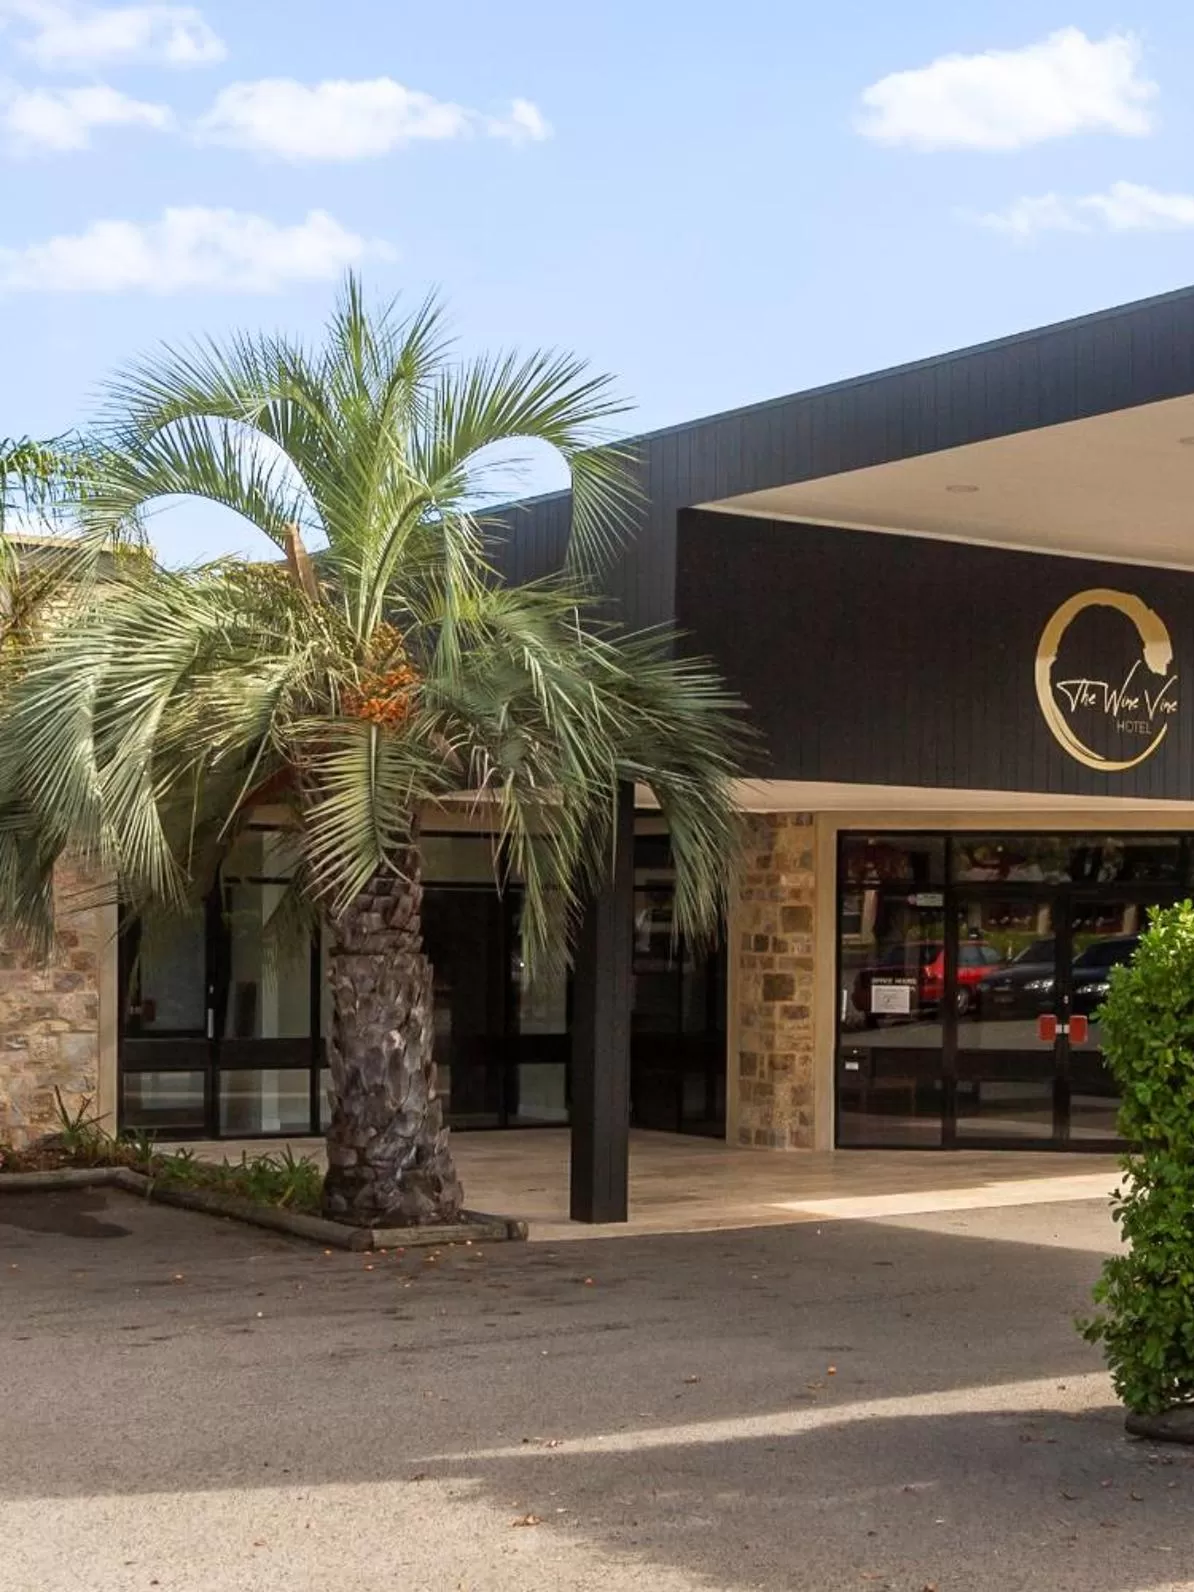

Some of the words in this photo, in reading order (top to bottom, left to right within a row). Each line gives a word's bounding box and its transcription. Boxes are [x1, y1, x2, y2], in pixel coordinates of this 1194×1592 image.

[1056, 678, 1104, 713] The
[1104, 660, 1141, 717] Wine
[1144, 675, 1178, 720] Vine
[1116, 721, 1152, 734] HOTEL
